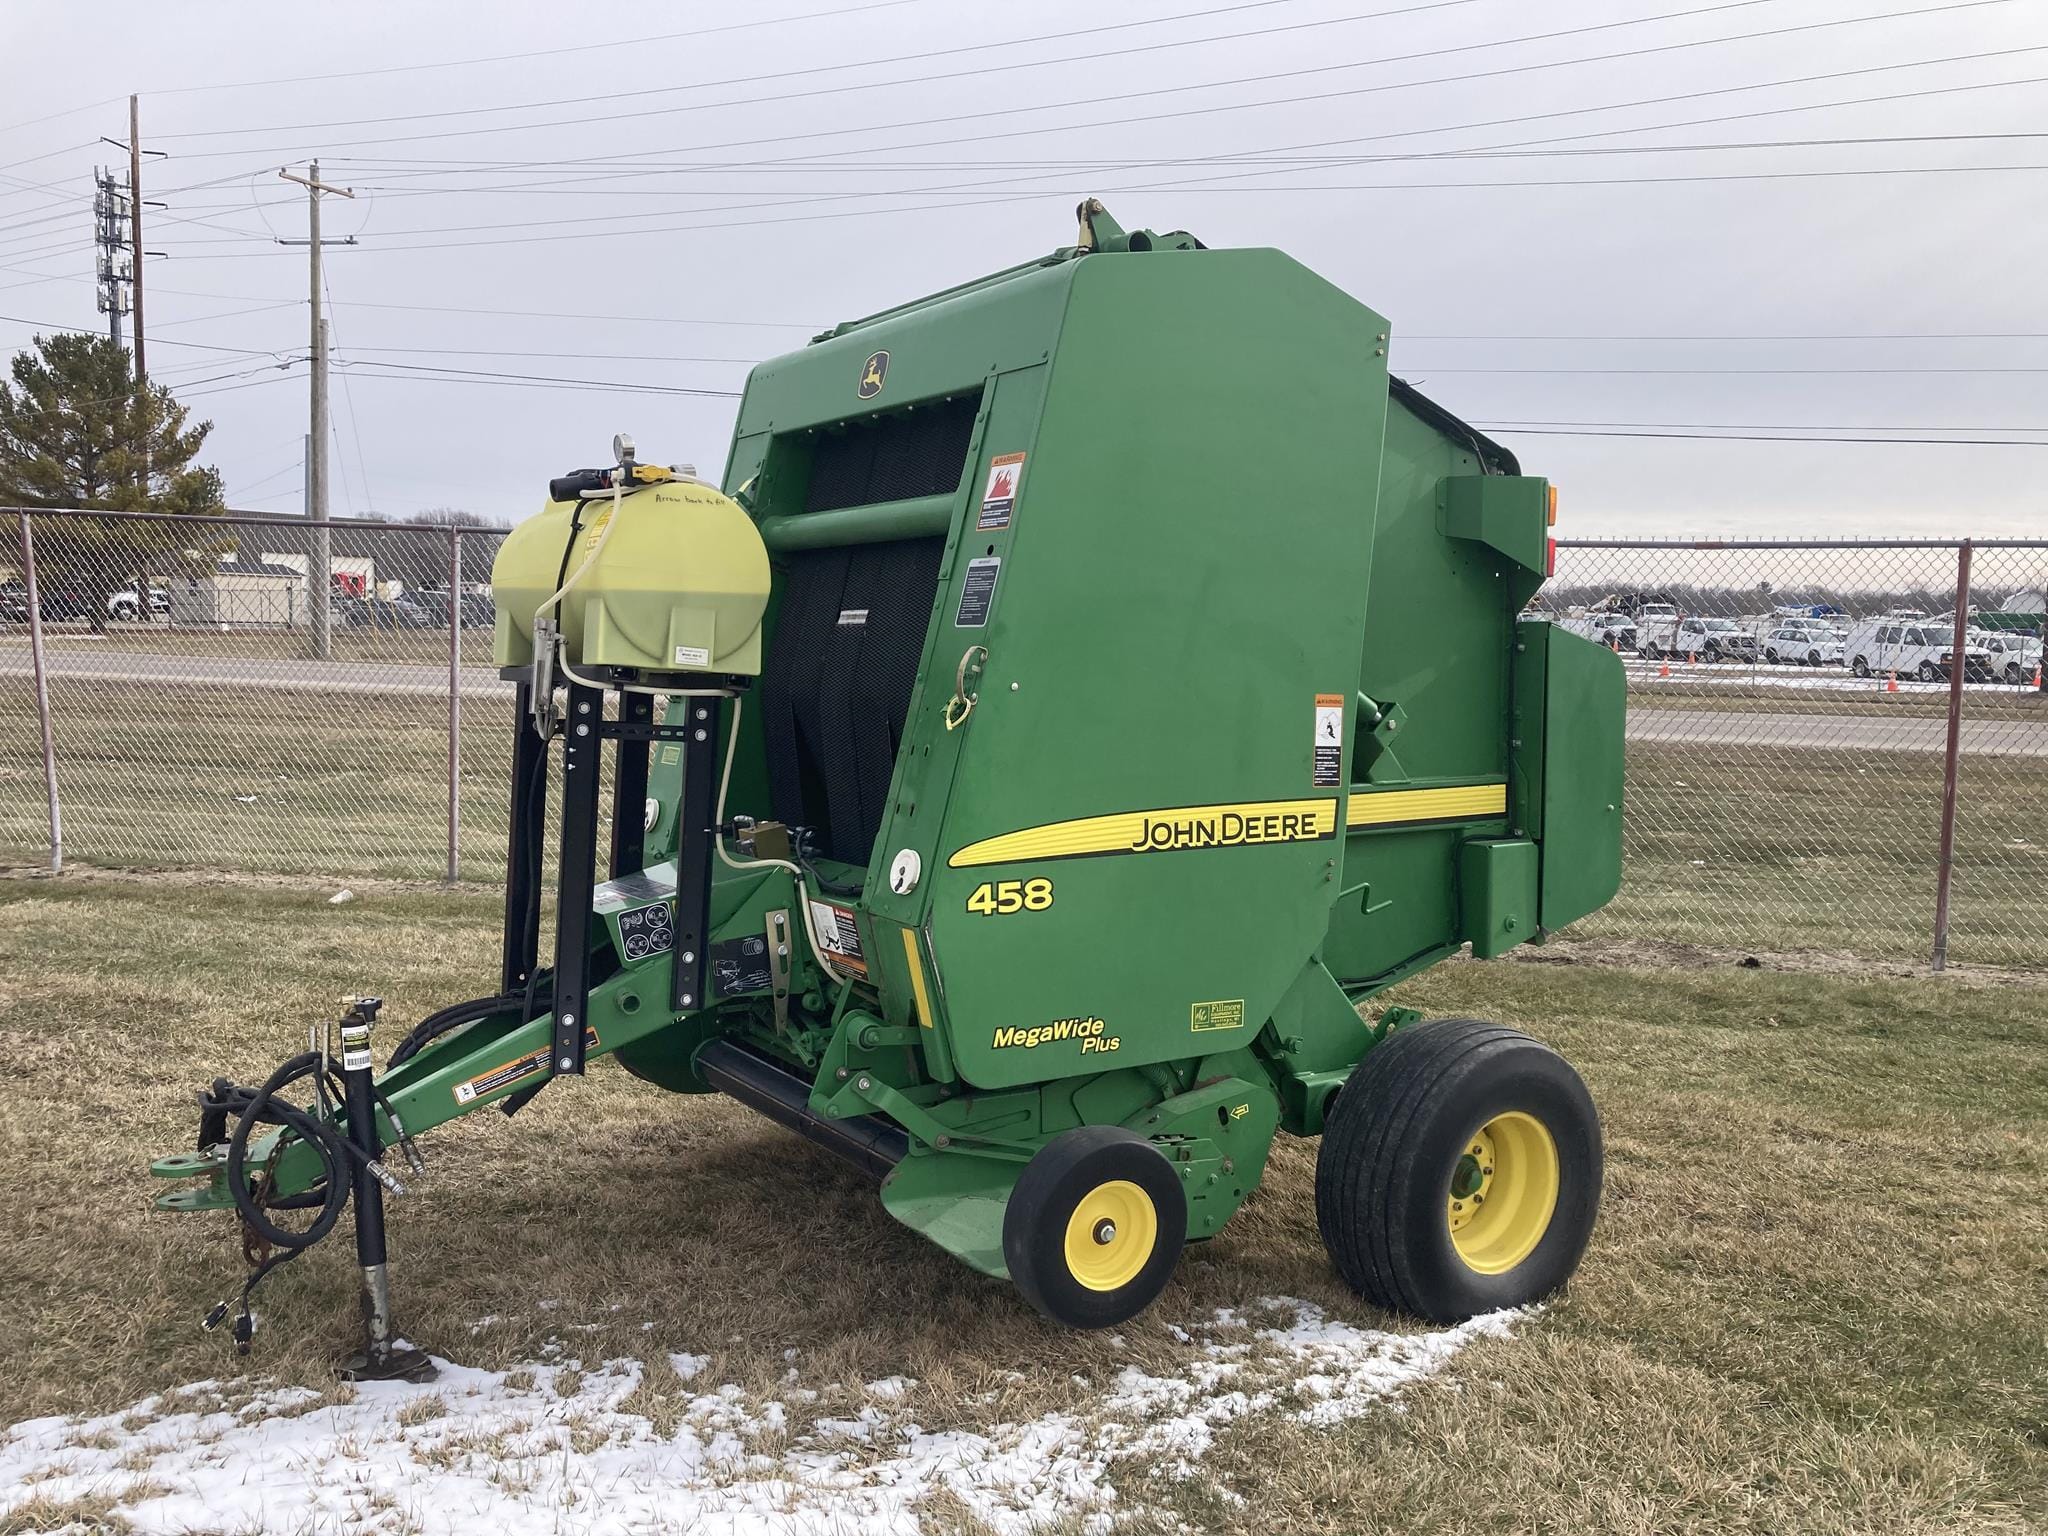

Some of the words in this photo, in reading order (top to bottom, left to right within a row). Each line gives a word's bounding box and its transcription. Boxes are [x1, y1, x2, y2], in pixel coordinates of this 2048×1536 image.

[655, 494, 680, 503] Arrow
[684, 495, 703, 504] back
[1132, 818, 1216, 848] JOHN
[1221, 812, 1317, 841] DEERE
[967, 877, 1053, 916] 458
[1211, 1003, 1241, 1012] Fillmore
[992, 1016, 1105, 1049] MegaWide
[1081, 1036, 1121, 1055] Plus
